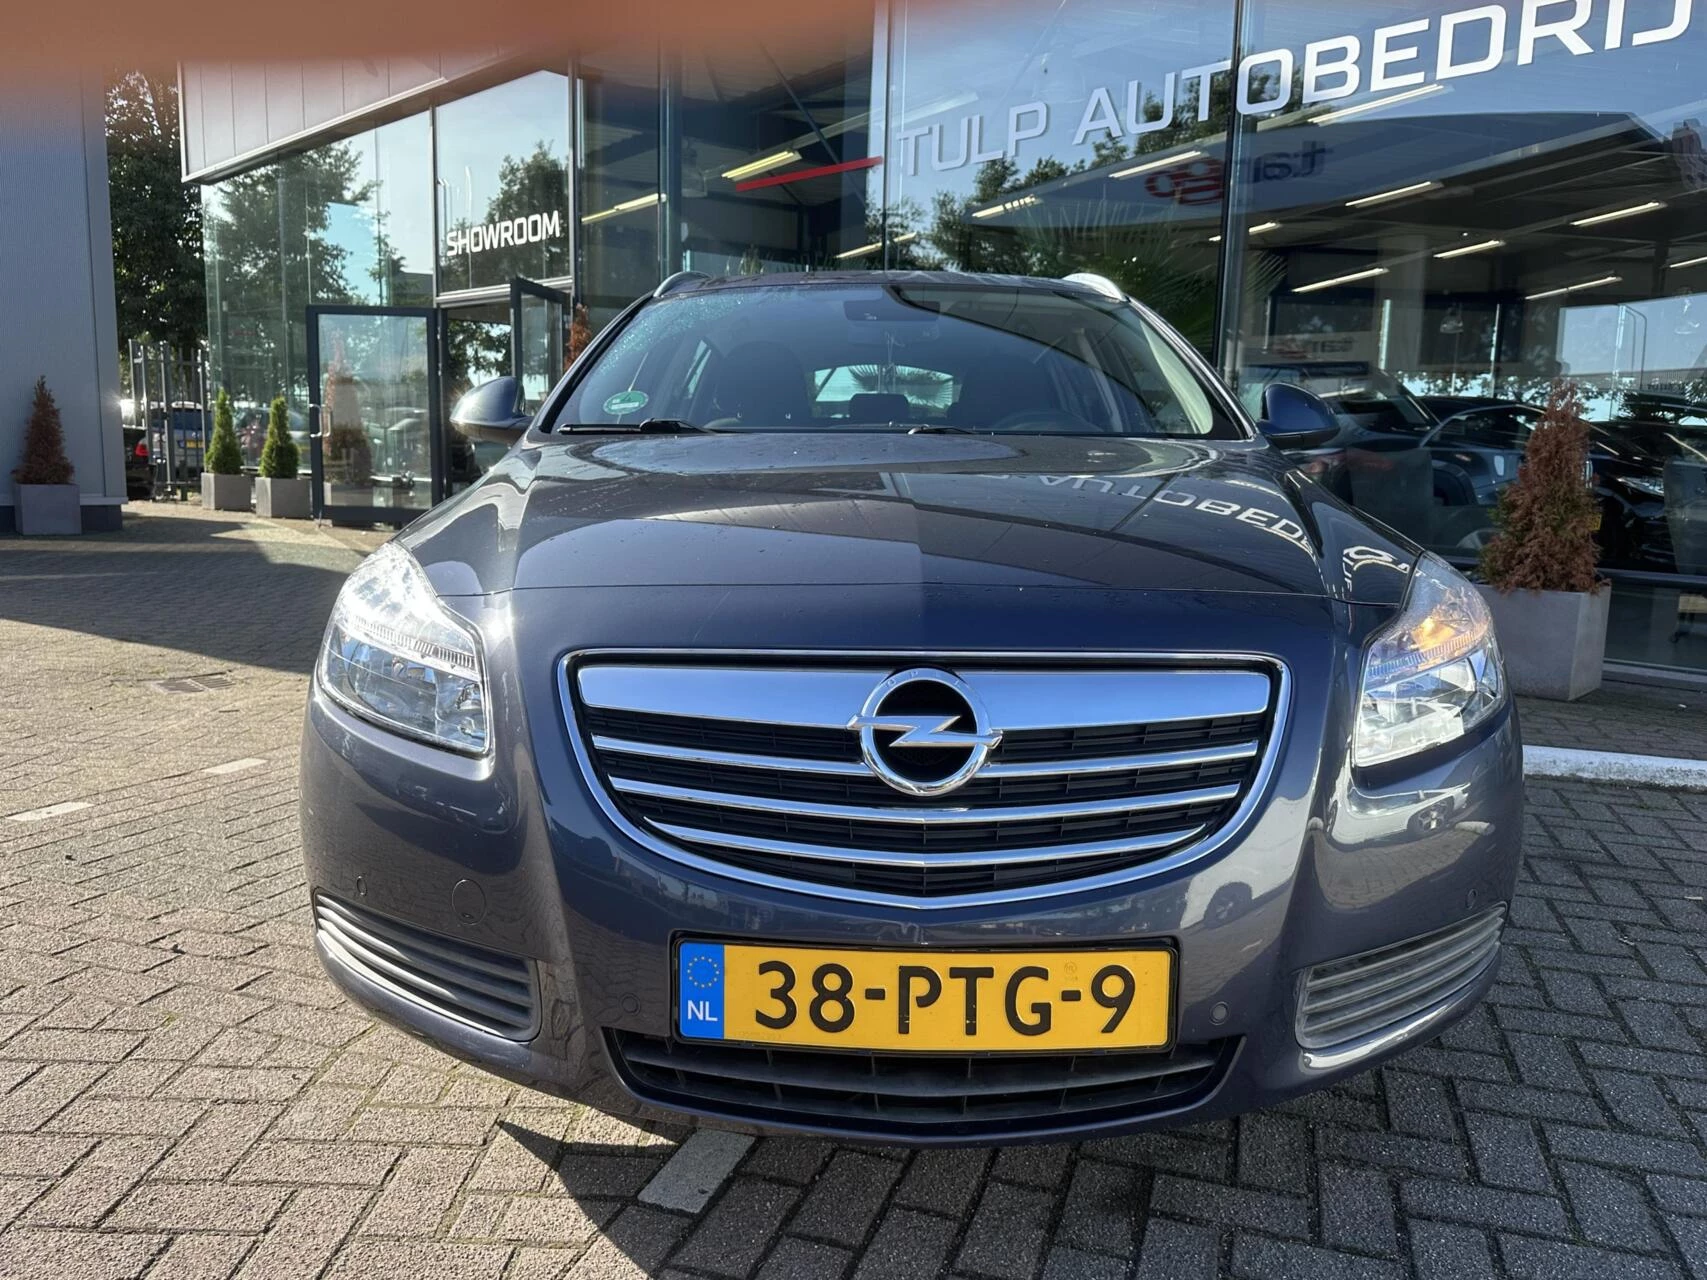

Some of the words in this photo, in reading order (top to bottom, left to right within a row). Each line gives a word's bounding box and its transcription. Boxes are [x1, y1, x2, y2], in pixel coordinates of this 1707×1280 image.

[899, 101, 1049, 177] TULP
[1072, 0, 1692, 145] AUTOBEDRIJ
[446, 210, 561, 257] SHOWROOM
[686, 1000, 718, 1022] NL
[754, 960, 1137, 1036] 38-PTG-9
